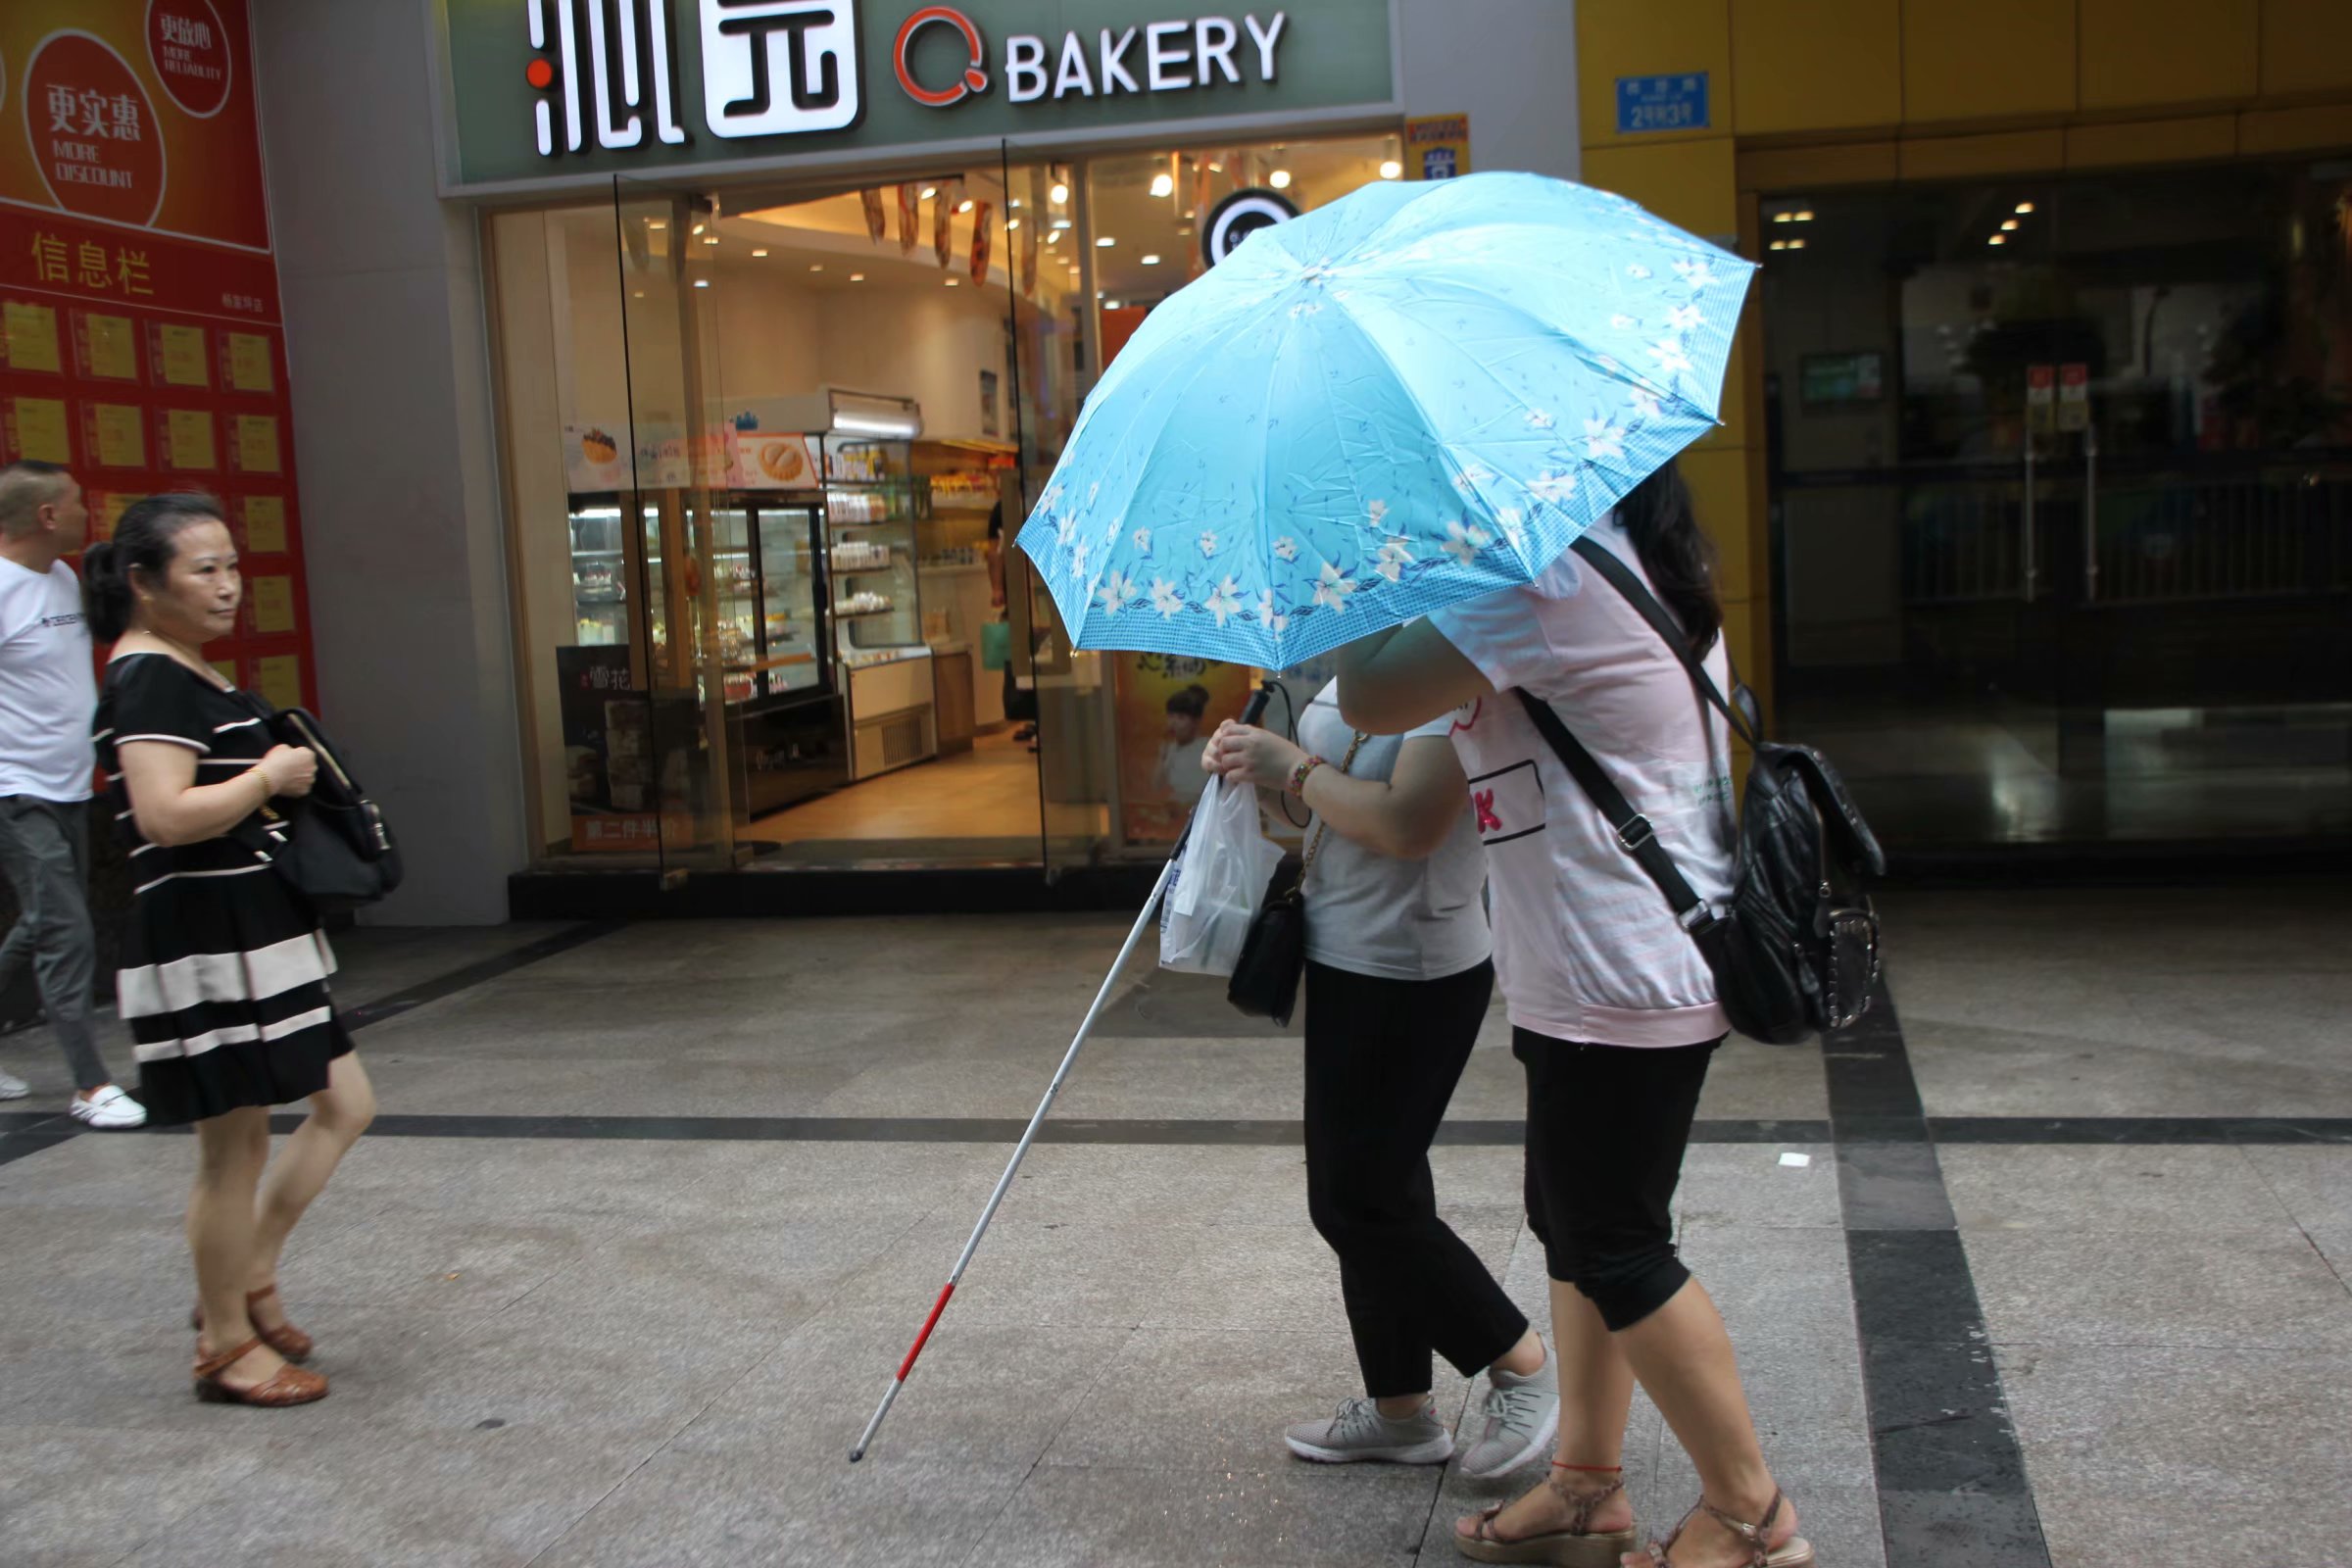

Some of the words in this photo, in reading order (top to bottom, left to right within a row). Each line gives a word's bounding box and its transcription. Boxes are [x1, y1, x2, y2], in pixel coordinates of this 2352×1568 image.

[158, 15, 212, 50] 更放心
[163, 46, 193, 62] MORE
[1004, 11, 1286, 104] BAKERY
[45, 83, 142, 142] 更实惠
[53, 139, 100, 164] MORE
[55, 164, 133, 189] DISCOUNT
[31, 231, 154, 296] 信息栏
